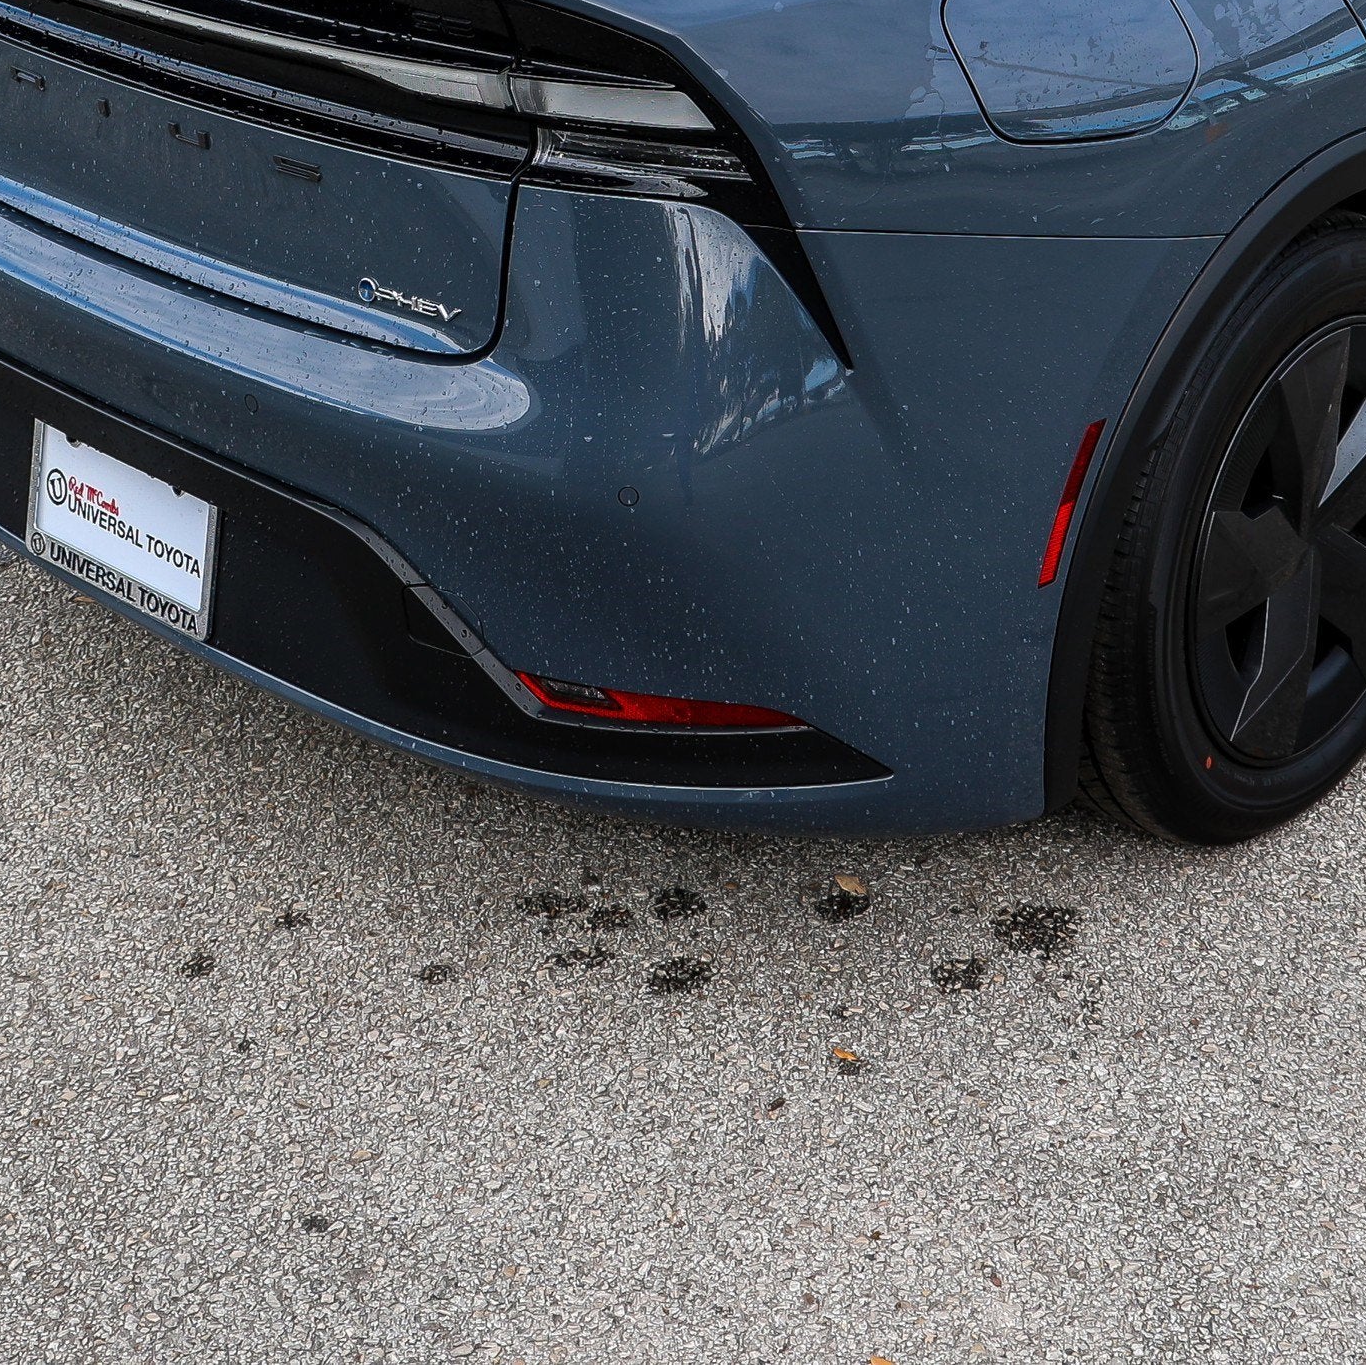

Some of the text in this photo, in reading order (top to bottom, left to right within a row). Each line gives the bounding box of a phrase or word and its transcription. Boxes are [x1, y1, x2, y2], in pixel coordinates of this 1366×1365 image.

[375, 287, 462, 322] PHEV
[68, 493, 201, 579] UNIVERSAL TOYOTA
[50, 541, 199, 635] UNIVERSAL TOYOTA
